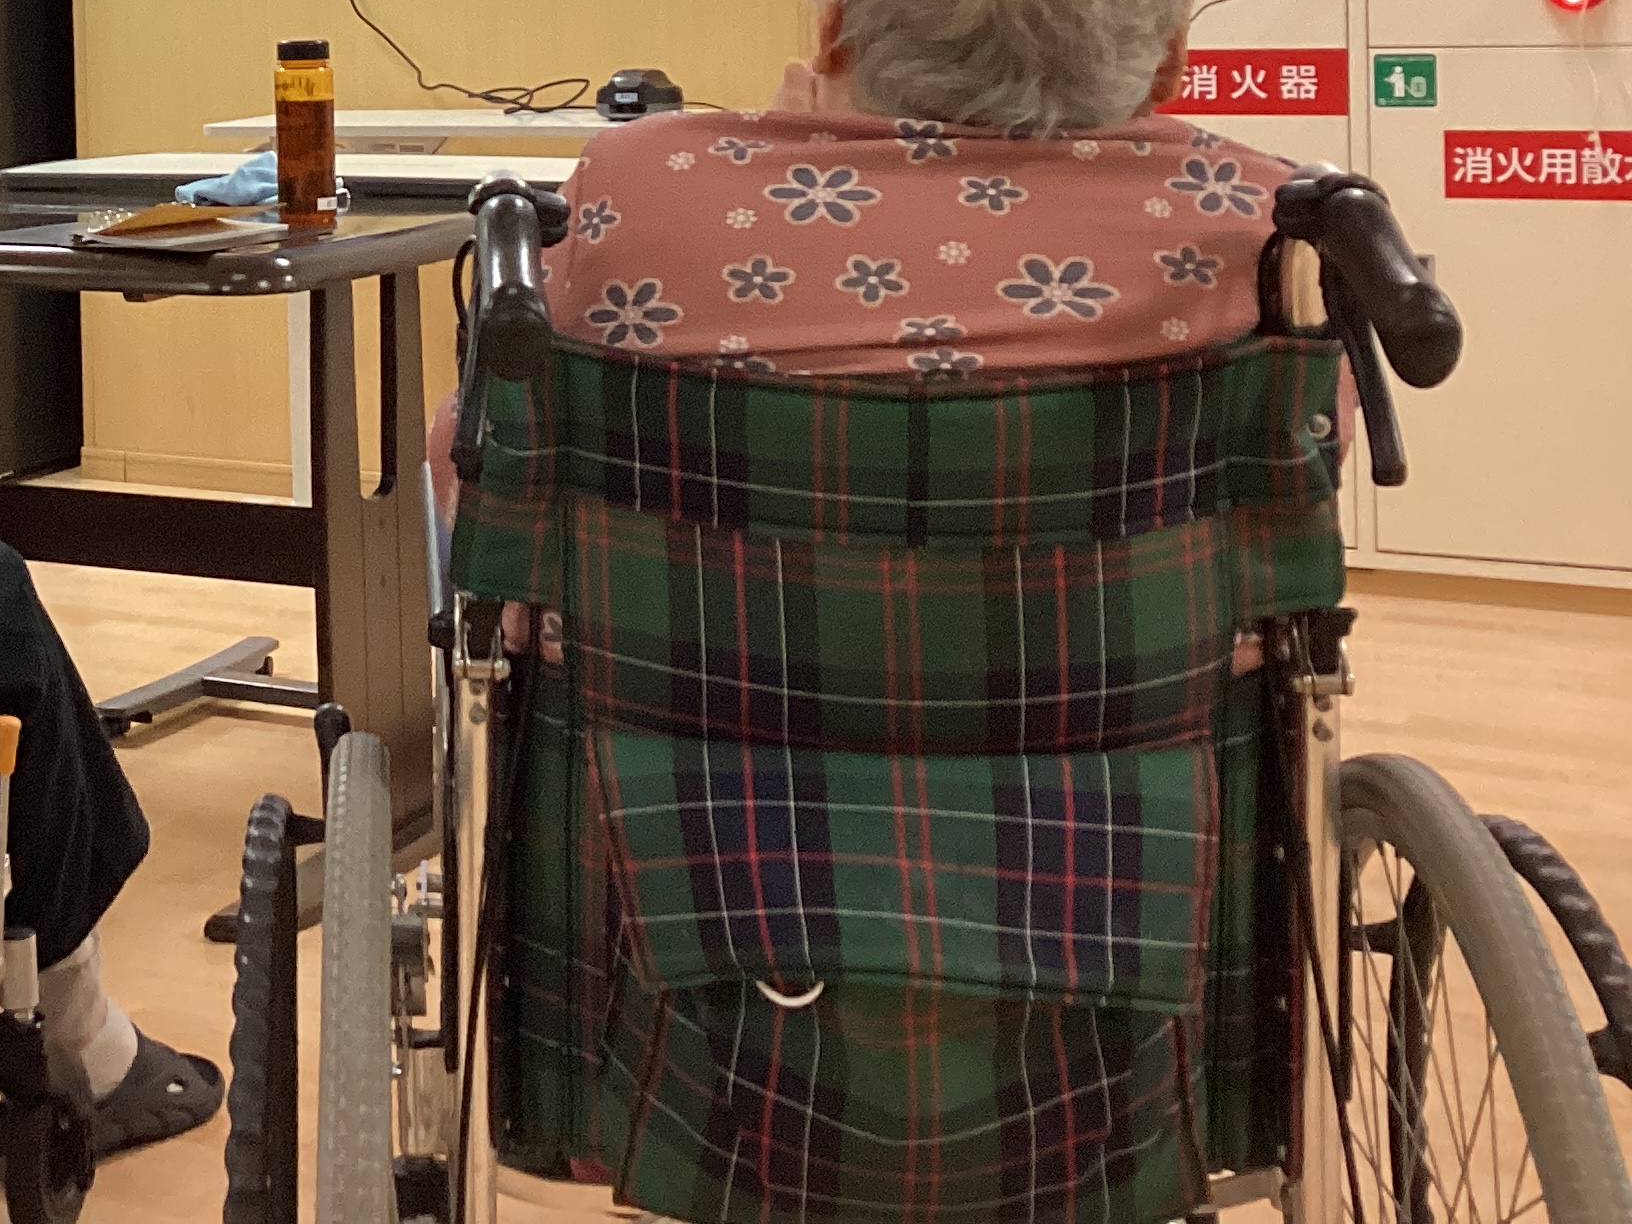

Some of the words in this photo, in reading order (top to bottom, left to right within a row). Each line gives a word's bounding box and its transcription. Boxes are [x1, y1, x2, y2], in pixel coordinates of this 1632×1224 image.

[1181, 64, 1319, 100] 消火器
[1453, 146, 1632, 185] 消火用散
